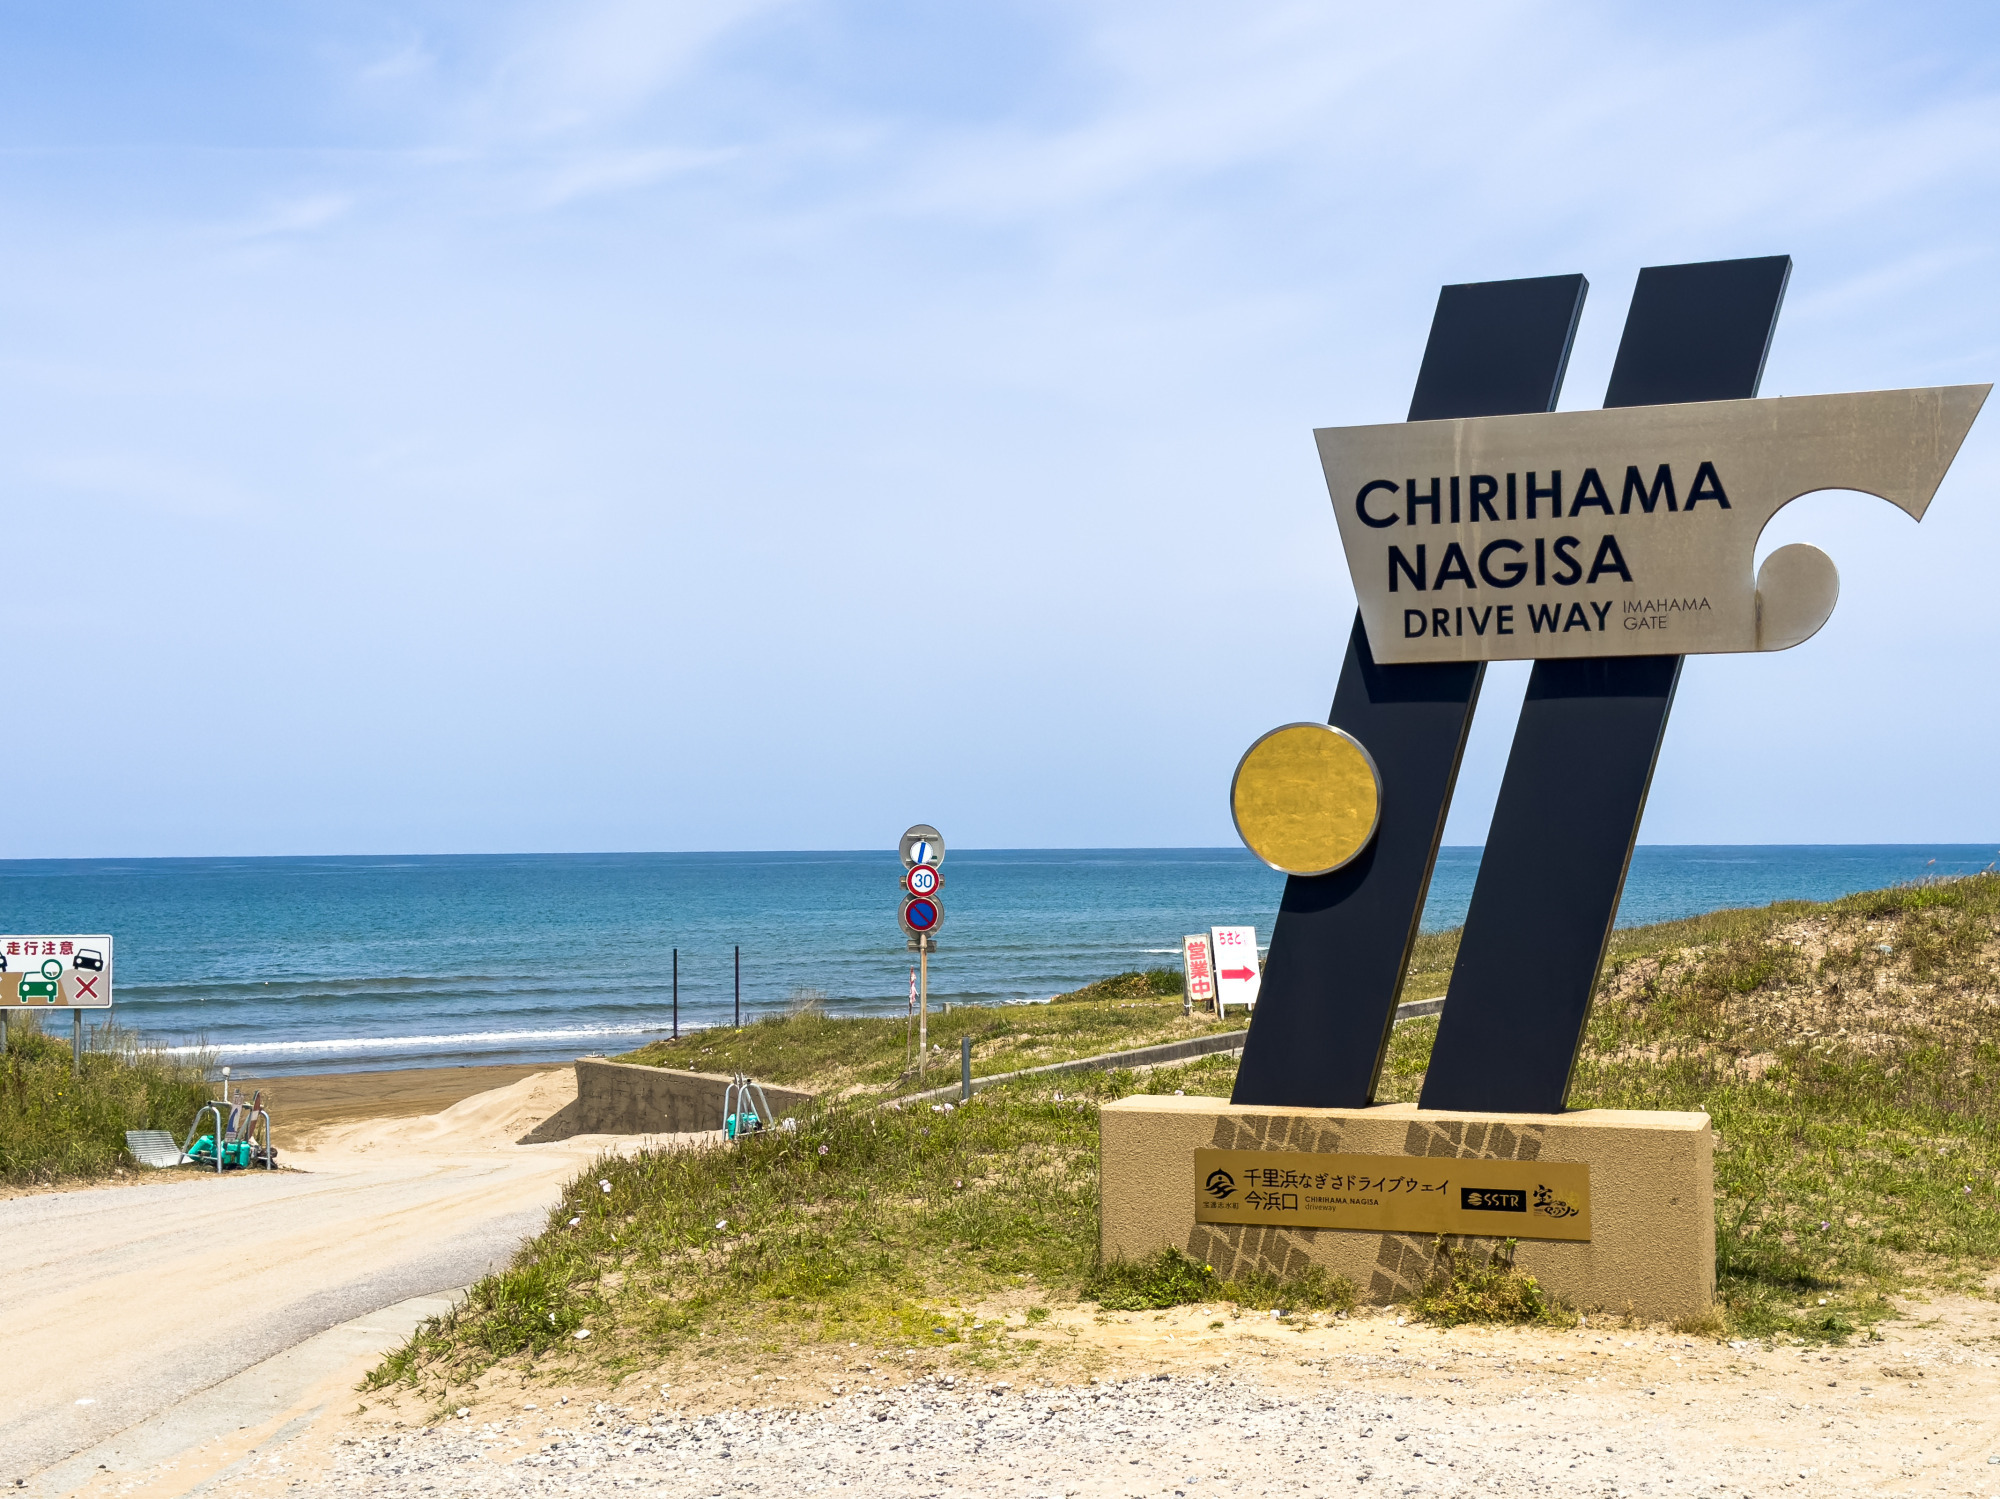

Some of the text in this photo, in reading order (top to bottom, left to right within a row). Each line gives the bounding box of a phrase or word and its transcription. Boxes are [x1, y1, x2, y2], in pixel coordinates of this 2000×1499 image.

[1356, 461, 1732, 529] CHIRIHAMA
[1388, 534, 1633, 592] NAGISA
[1622, 597, 1712, 614] IMAHAMA
[1404, 600, 1613, 638] DRIVE WAY
[1623, 614, 1668, 631] GATE
[915, 874, 932, 888] 30
[6, 941, 74, 956] 走行注意
[1188, 941, 1210, 994] 営業中
[1243, 1168, 1449, 1195] 千里浜なぎさドライブウェイ
[1244, 1190, 1298, 1212] 今浜口
[1304, 1196, 1379, 1206] CHIRIHAMA NAGISA
[1484, 1194, 1519, 1207] SSTR
